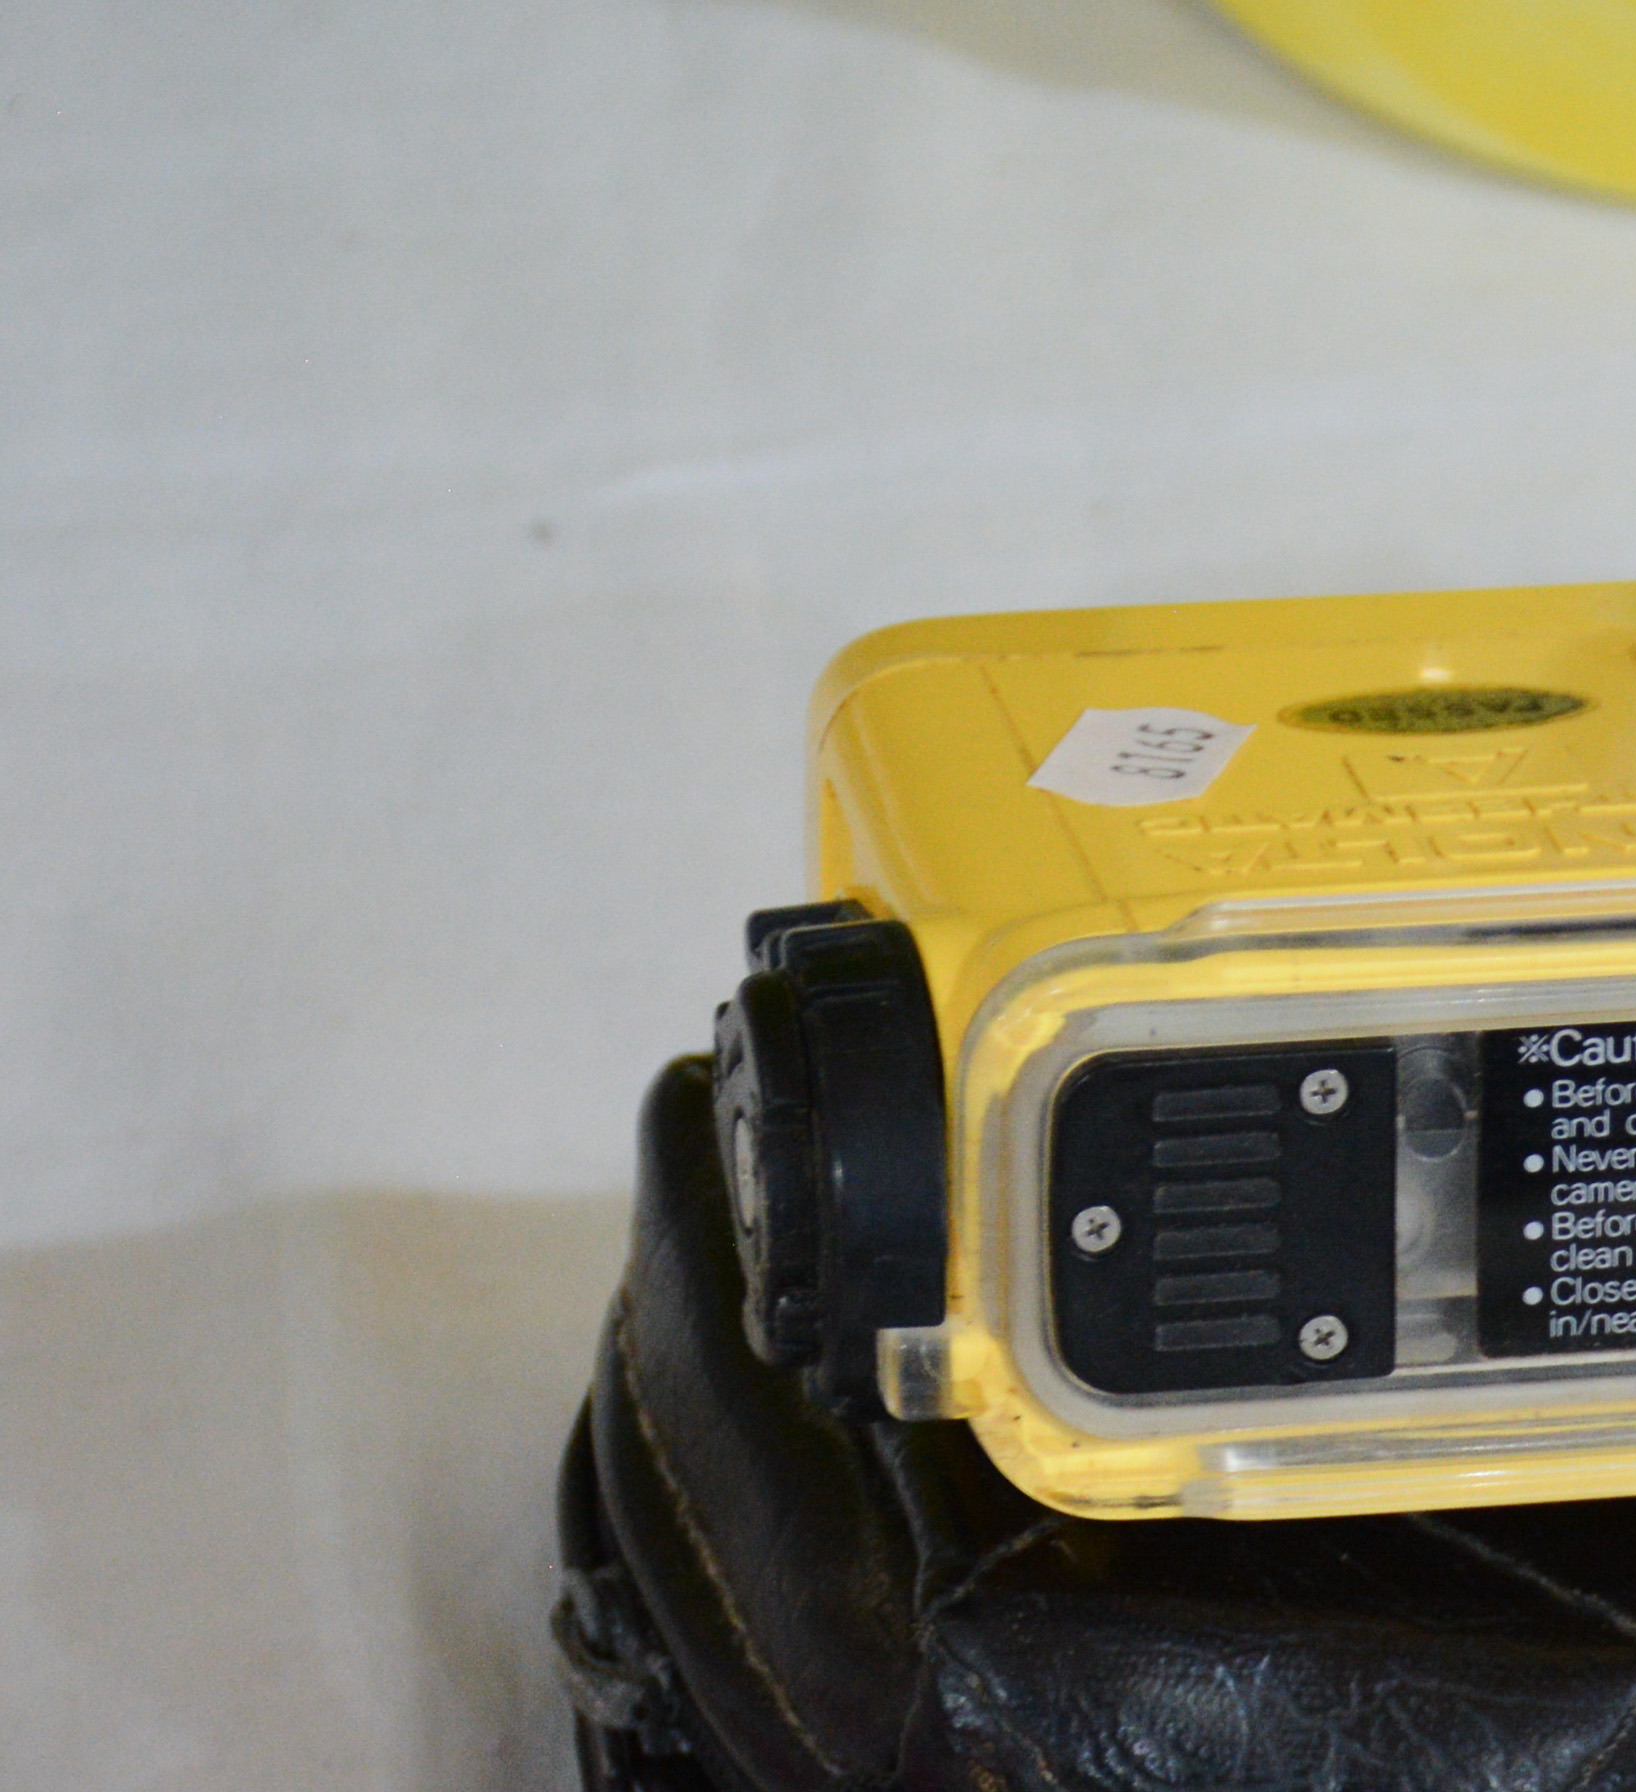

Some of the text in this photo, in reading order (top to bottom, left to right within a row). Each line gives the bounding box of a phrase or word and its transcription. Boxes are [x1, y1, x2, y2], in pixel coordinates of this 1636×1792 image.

[1110, 722, 1215, 780] 8165
[1552, 1112, 1610, 1139] and
[1551, 1242, 1633, 1273] clean
